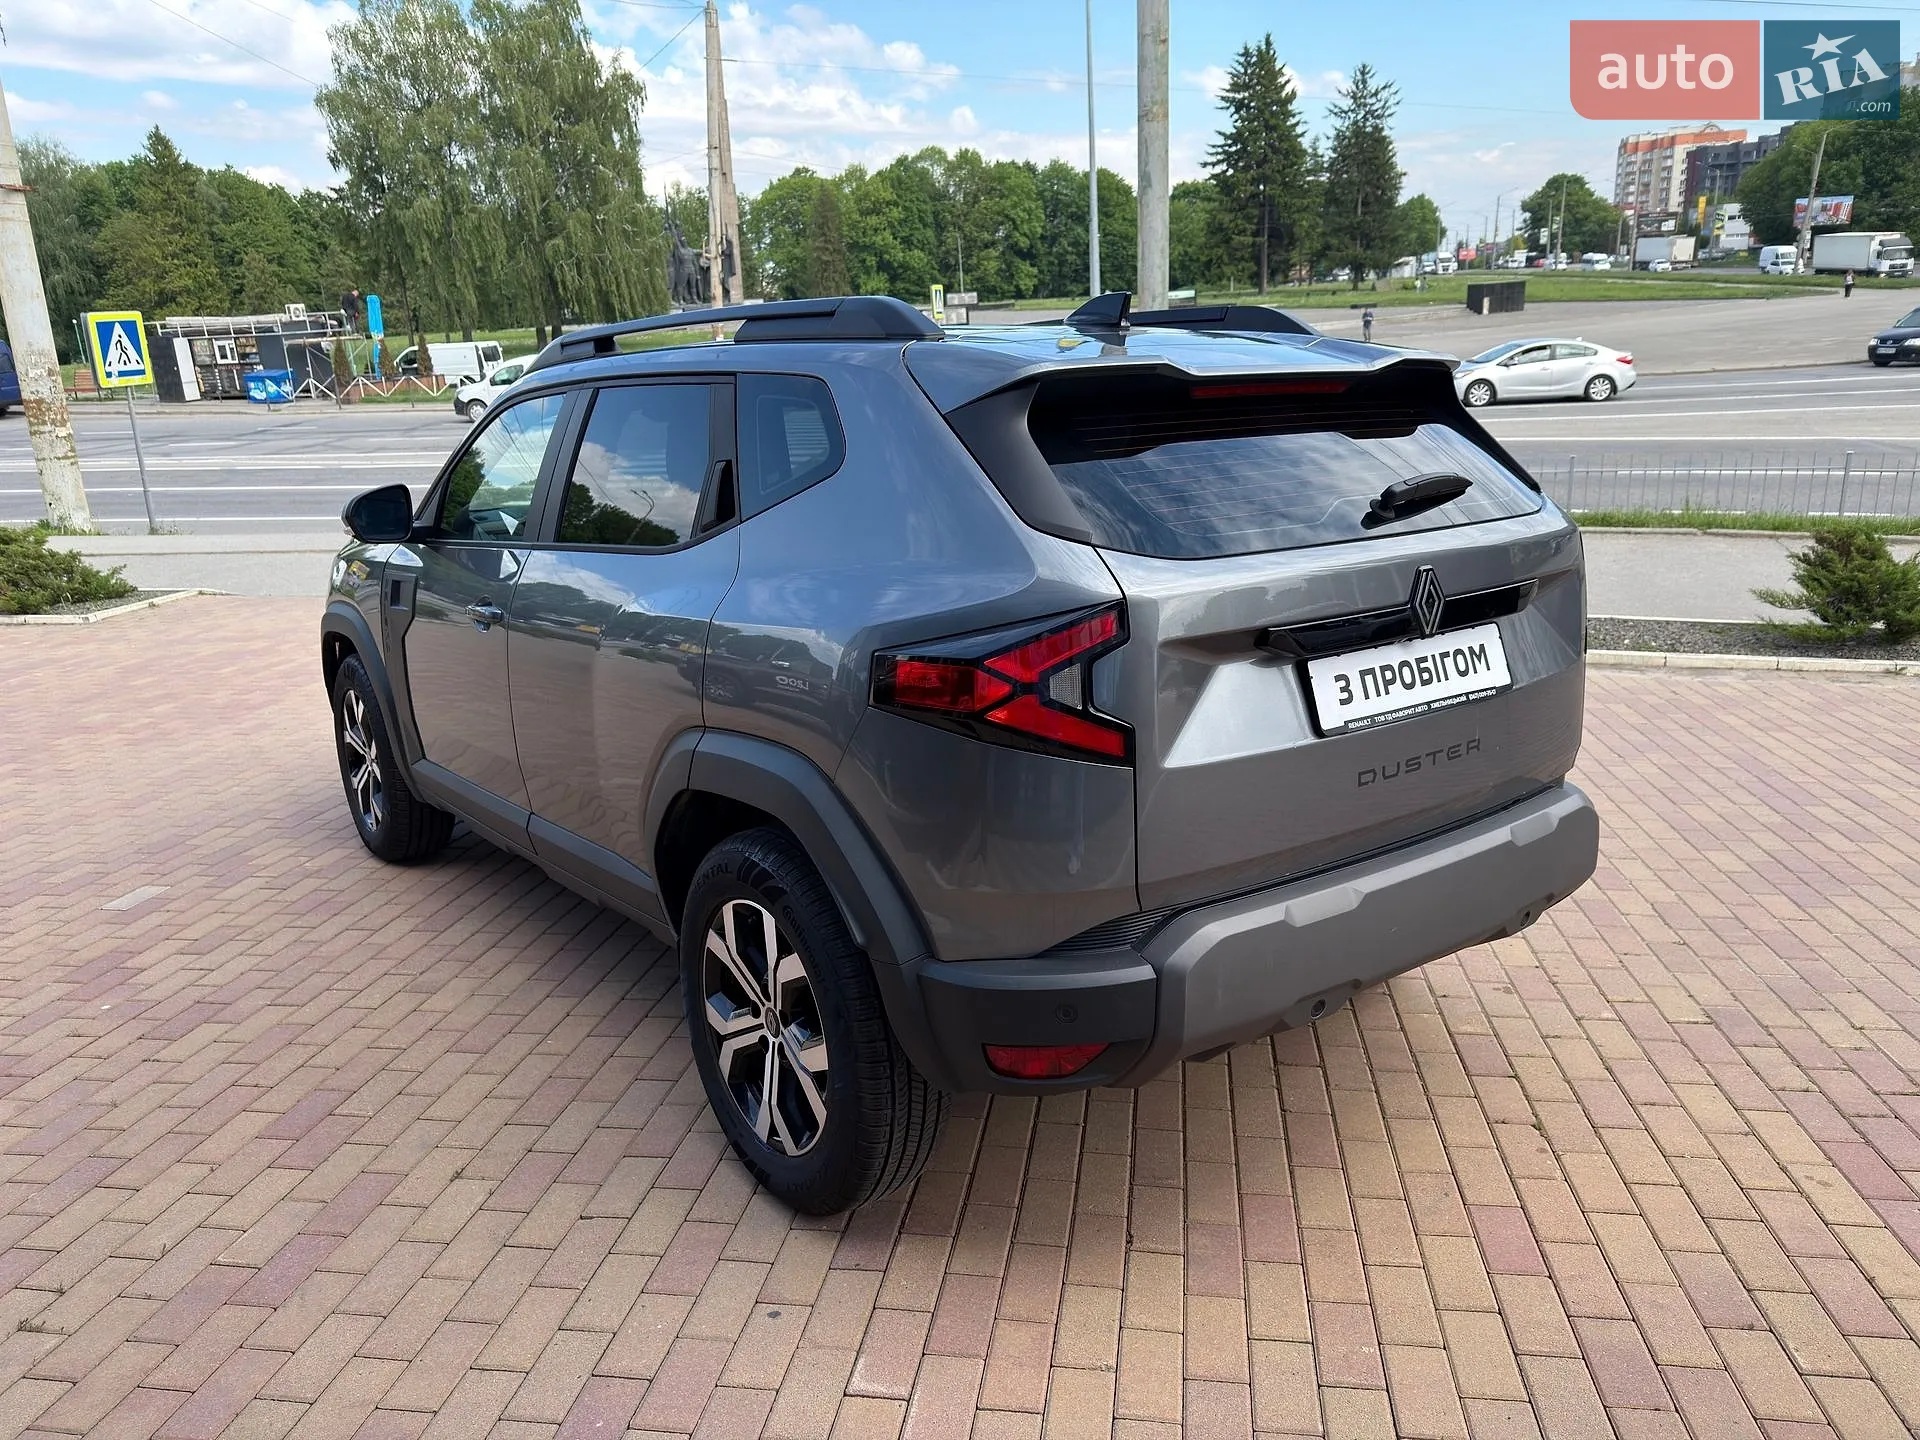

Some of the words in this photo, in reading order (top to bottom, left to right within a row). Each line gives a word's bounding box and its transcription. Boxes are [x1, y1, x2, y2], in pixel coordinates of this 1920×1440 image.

[1334, 673, 1354, 706] З
[1358, 643, 1491, 700] ПРОБІГОМ
[1348, 718, 1371, 729] RENAULT
[1357, 738, 1481, 788] DUSTER
